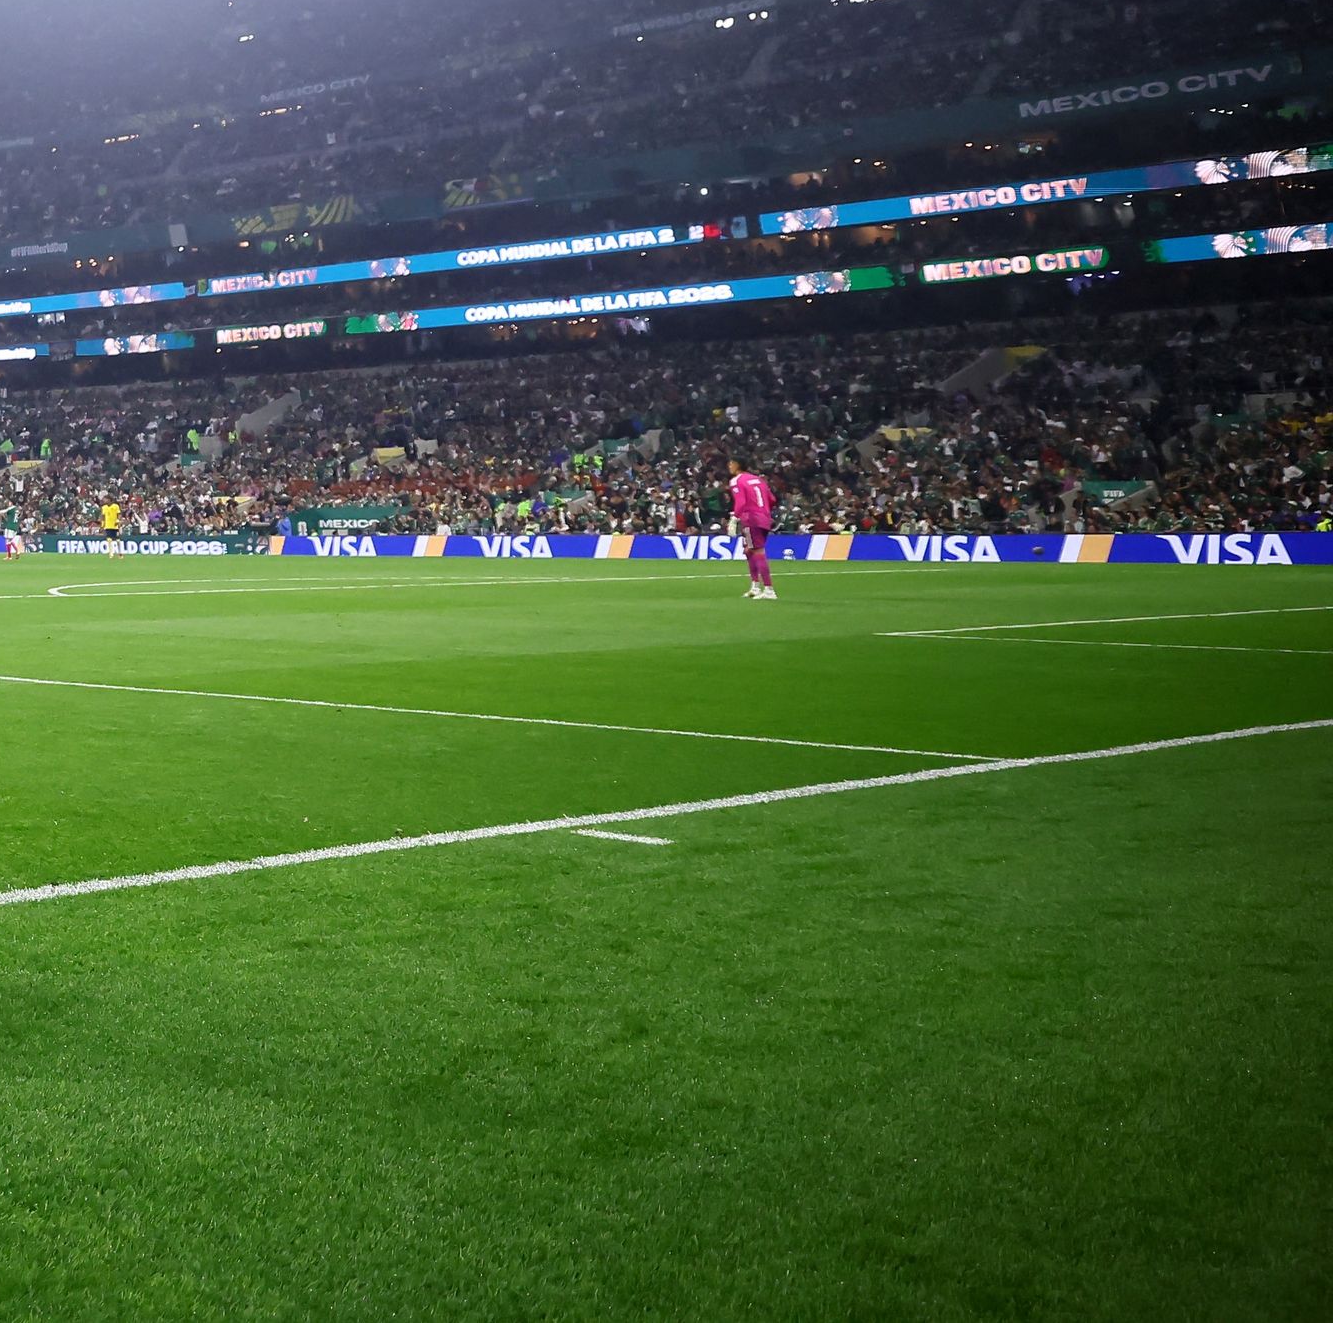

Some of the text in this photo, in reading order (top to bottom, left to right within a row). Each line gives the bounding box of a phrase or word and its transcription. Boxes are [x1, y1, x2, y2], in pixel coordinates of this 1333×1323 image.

[1019, 64, 1273, 118] MEXICO CITY
[909, 177, 1088, 215] MEXICO CITY
[457, 250, 498, 266] COPA
[498, 242, 571, 261] MUNDIAL
[572, 237, 593, 253] DE
[594, 234, 618, 251] LA
[619, 231, 657, 248] FIFA
[277, 269, 317, 286] CITY
[923, 248, 1103, 282] MEXICO CITY
[465, 284, 732, 323] COPA MUNDIAL DE LA FIFA 2026
[217, 321, 324, 345] MEXICO CITY
[753, 486, 764, 507] 1
[57, 540, 86, 554] FIFA
[139, 540, 169, 554] CUP
[170, 540, 222, 555] 2026
[307, 536, 377, 557] VISA
[473, 536, 552, 558] VISA
[888, 536, 1001, 562] VISA
[1155, 534, 1292, 565] VISA
